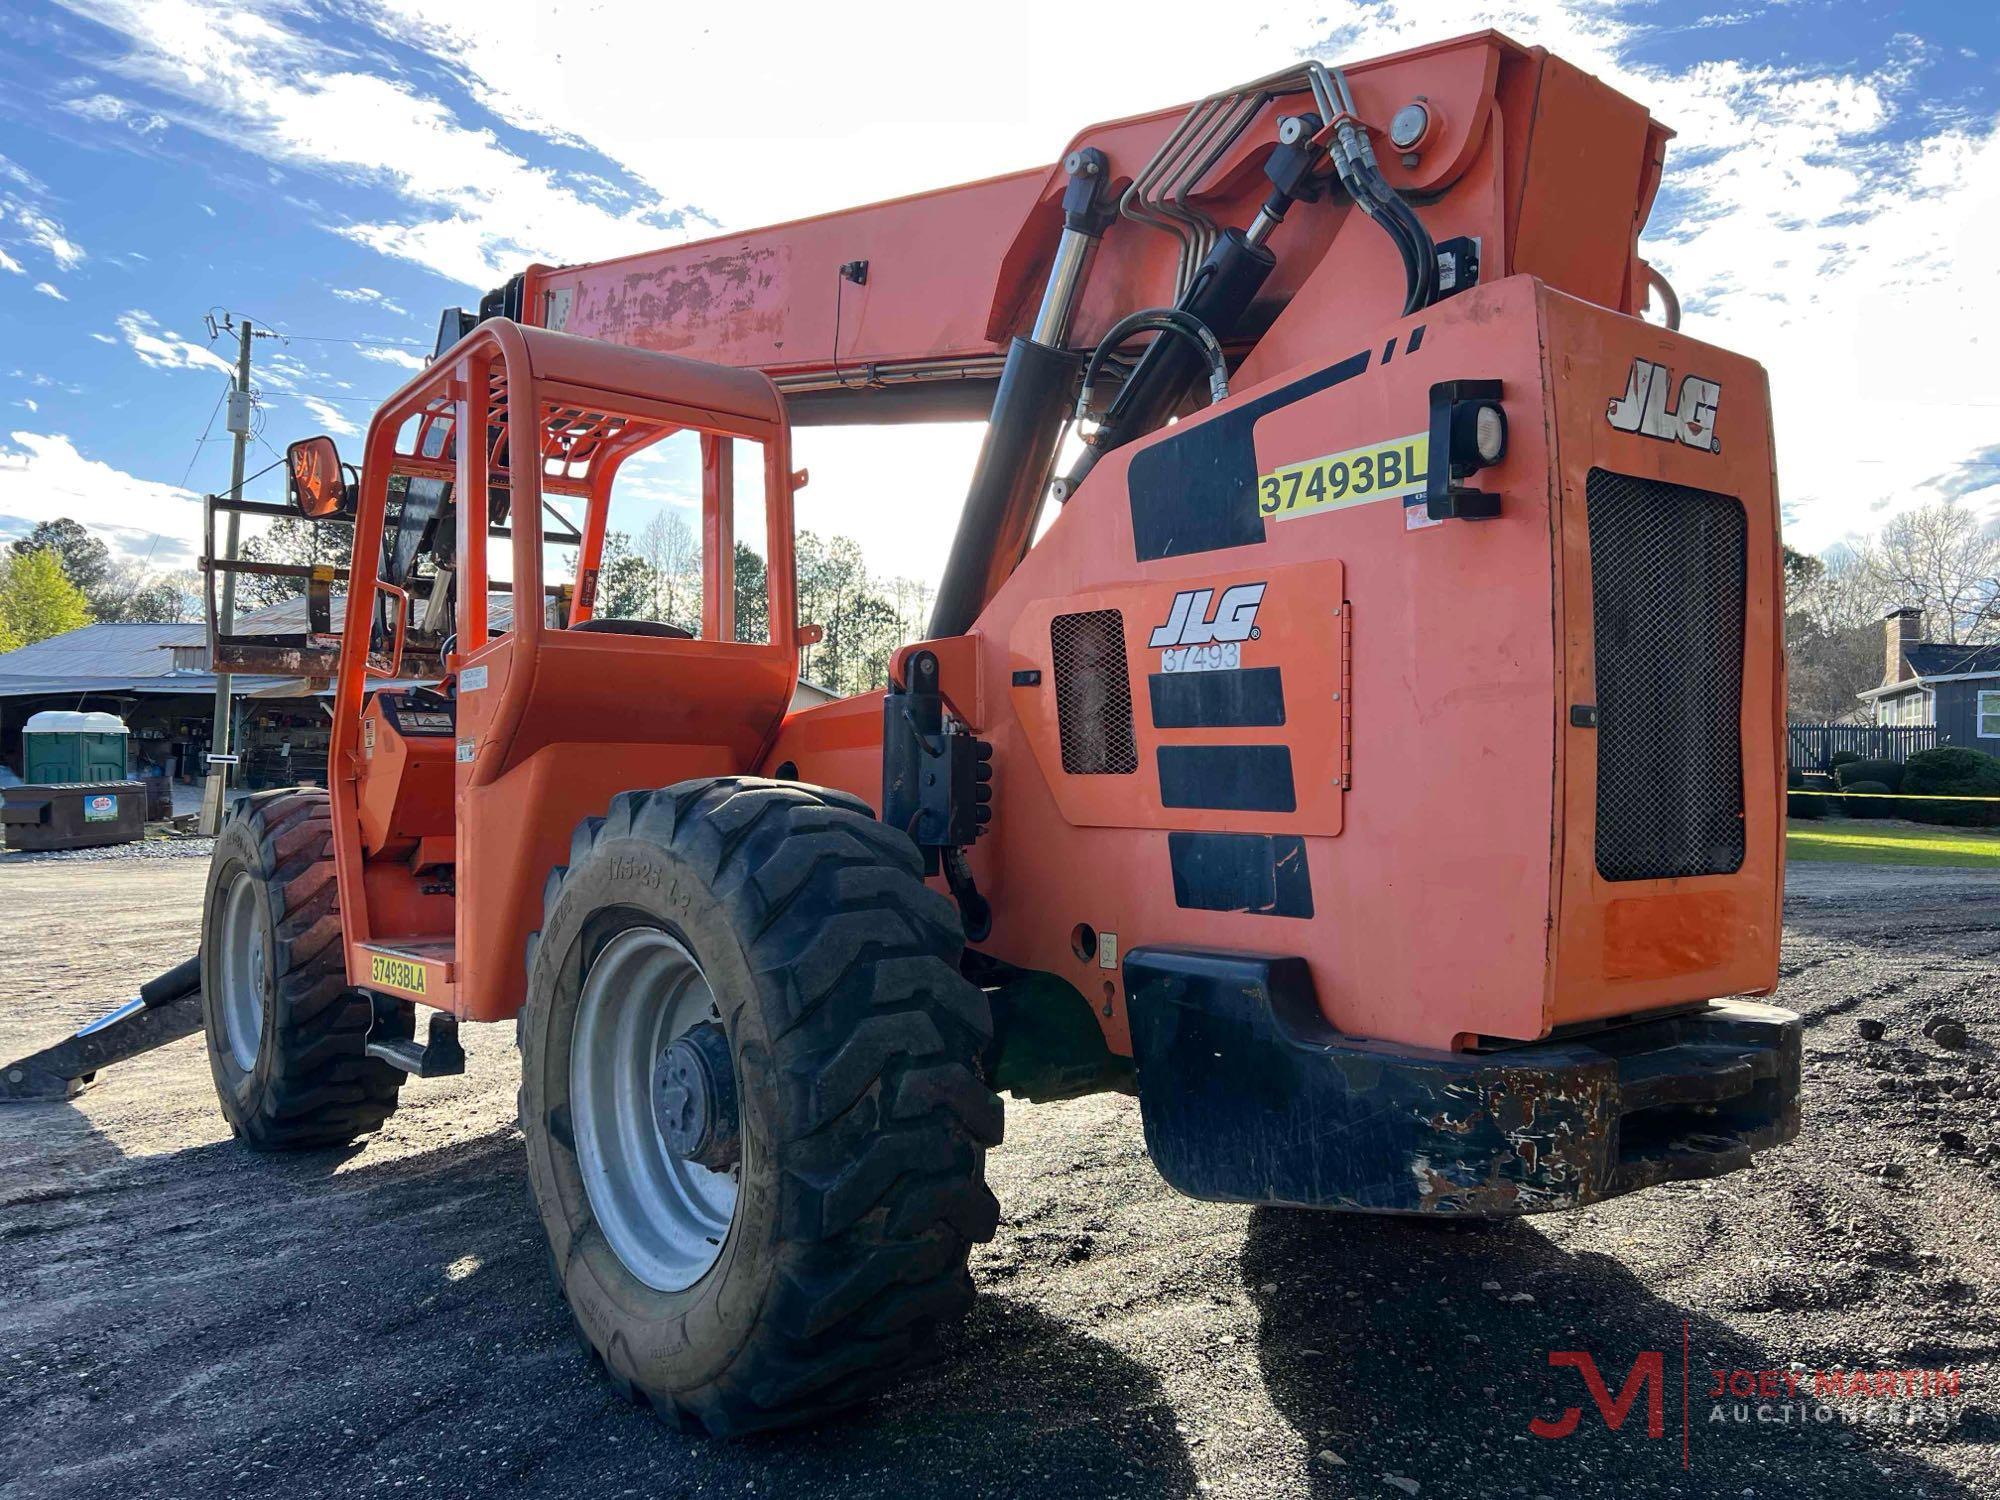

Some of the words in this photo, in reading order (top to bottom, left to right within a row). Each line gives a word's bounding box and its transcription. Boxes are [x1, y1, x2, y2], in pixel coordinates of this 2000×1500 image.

[1606, 357, 1721, 453] JLG
[1148, 581, 1267, 648] JLG
[1163, 643, 1238, 672] 37493
[372, 957, 425, 993] 37493BLA
